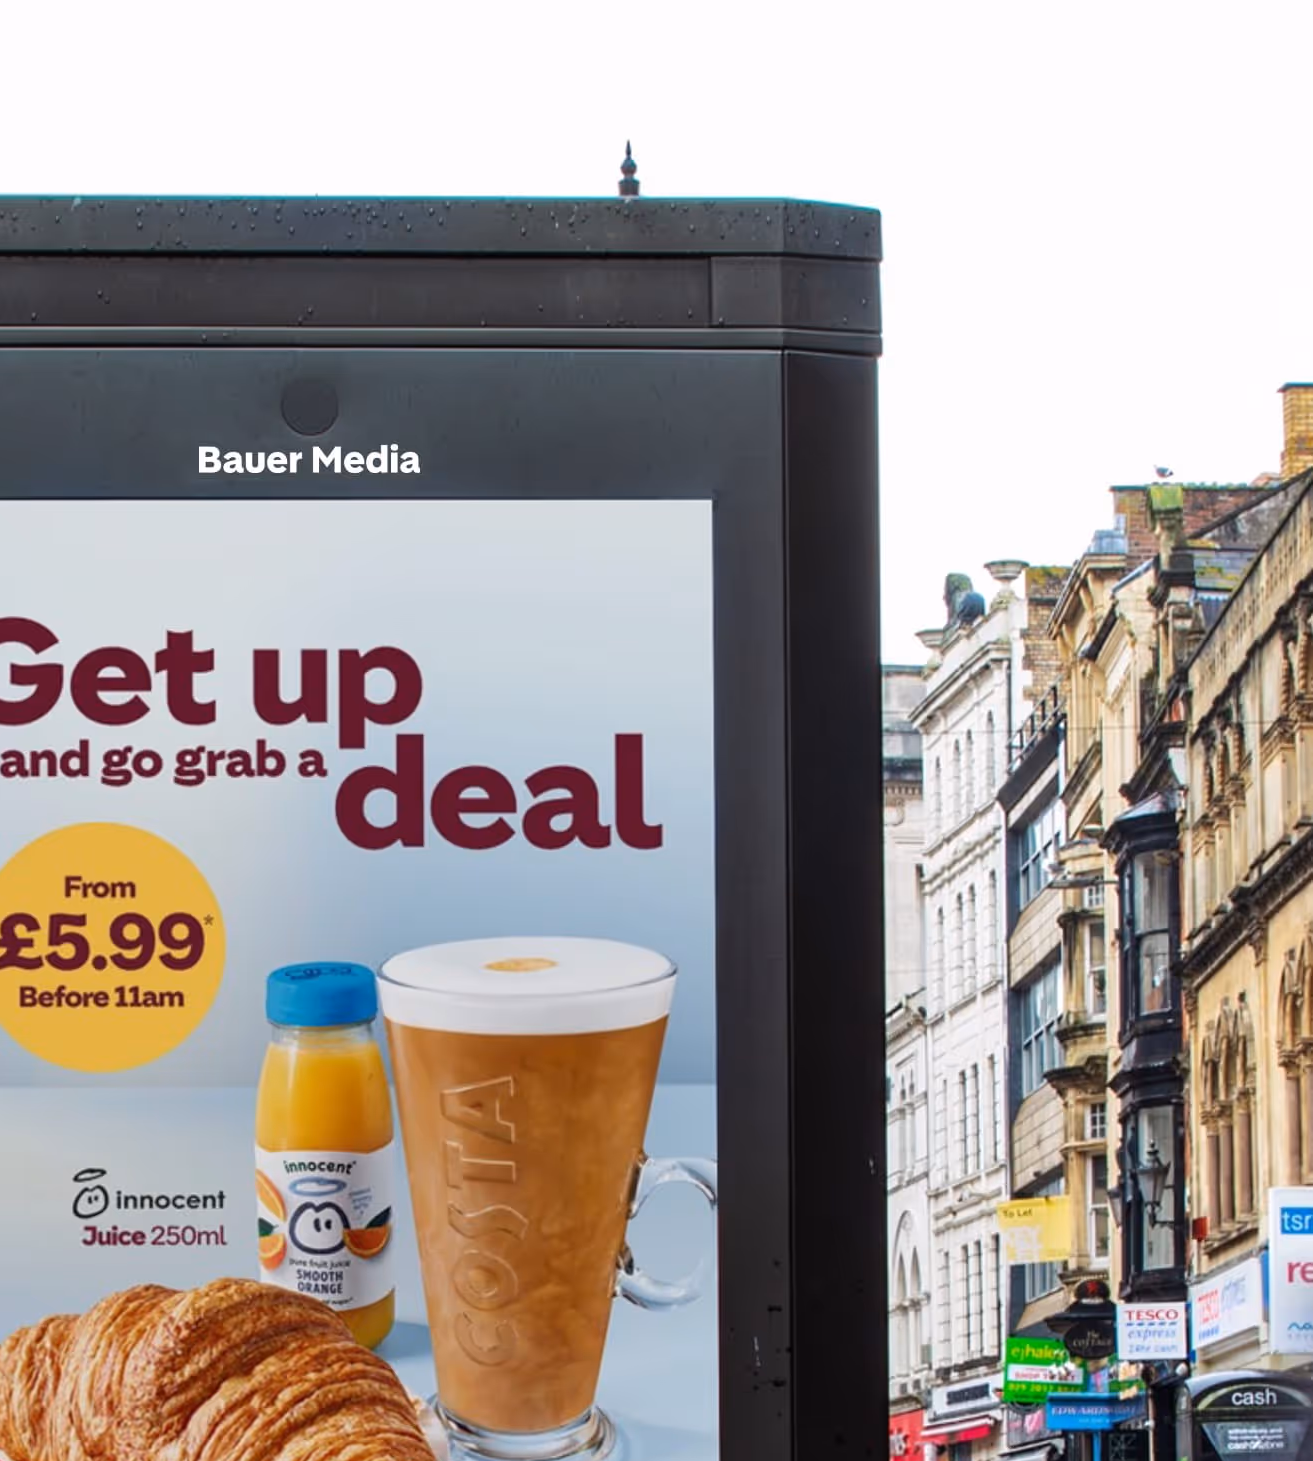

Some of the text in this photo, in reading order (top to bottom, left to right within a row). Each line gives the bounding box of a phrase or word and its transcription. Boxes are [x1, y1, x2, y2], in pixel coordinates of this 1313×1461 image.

[199, 444, 421, 474] Bauer Media
[253, 646, 424, 750] up
[0, 740, 328, 787] and go grab a
[335, 733, 663, 850] deal
[64, 875, 137, 899] From
[19, 985, 185, 1009] Before 11am
[283, 1160, 353, 1175] innocent
[116, 1190, 226, 1210] innocent
[440, 1076, 529, 1367] COSTA
[81, 1224, 228, 1247] Juice 250ml
[296, 1269, 344, 1282] SMOOTH
[297, 1282, 344, 1294] ORANGE
[1124, 1309, 1179, 1321] TESCO
[1231, 1387, 1278, 1406] cash
